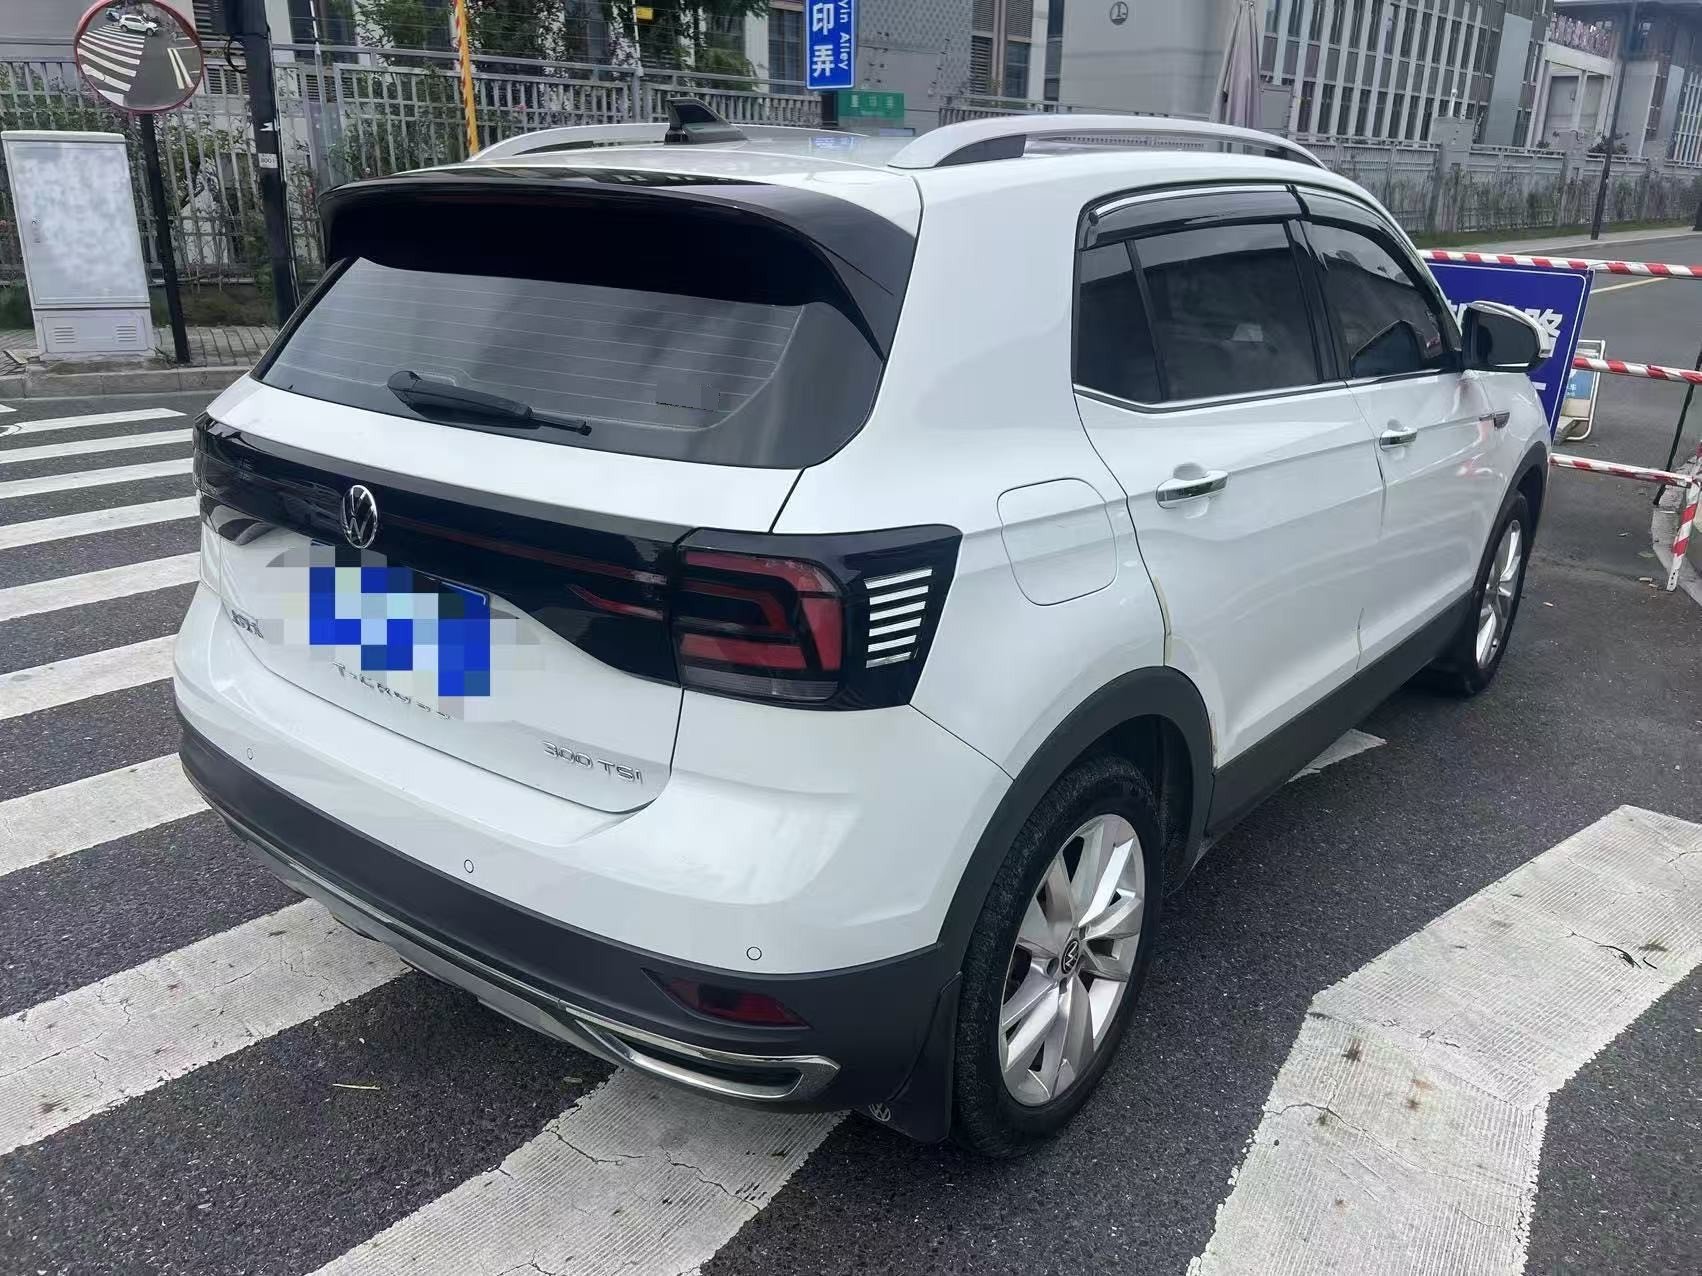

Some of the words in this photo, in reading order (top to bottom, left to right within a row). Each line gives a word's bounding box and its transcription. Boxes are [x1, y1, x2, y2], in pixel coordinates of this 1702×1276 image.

[838, 32, 851, 70] Alley
[543, 741, 593, 769] 300
[597, 759, 643, 785] TSI
